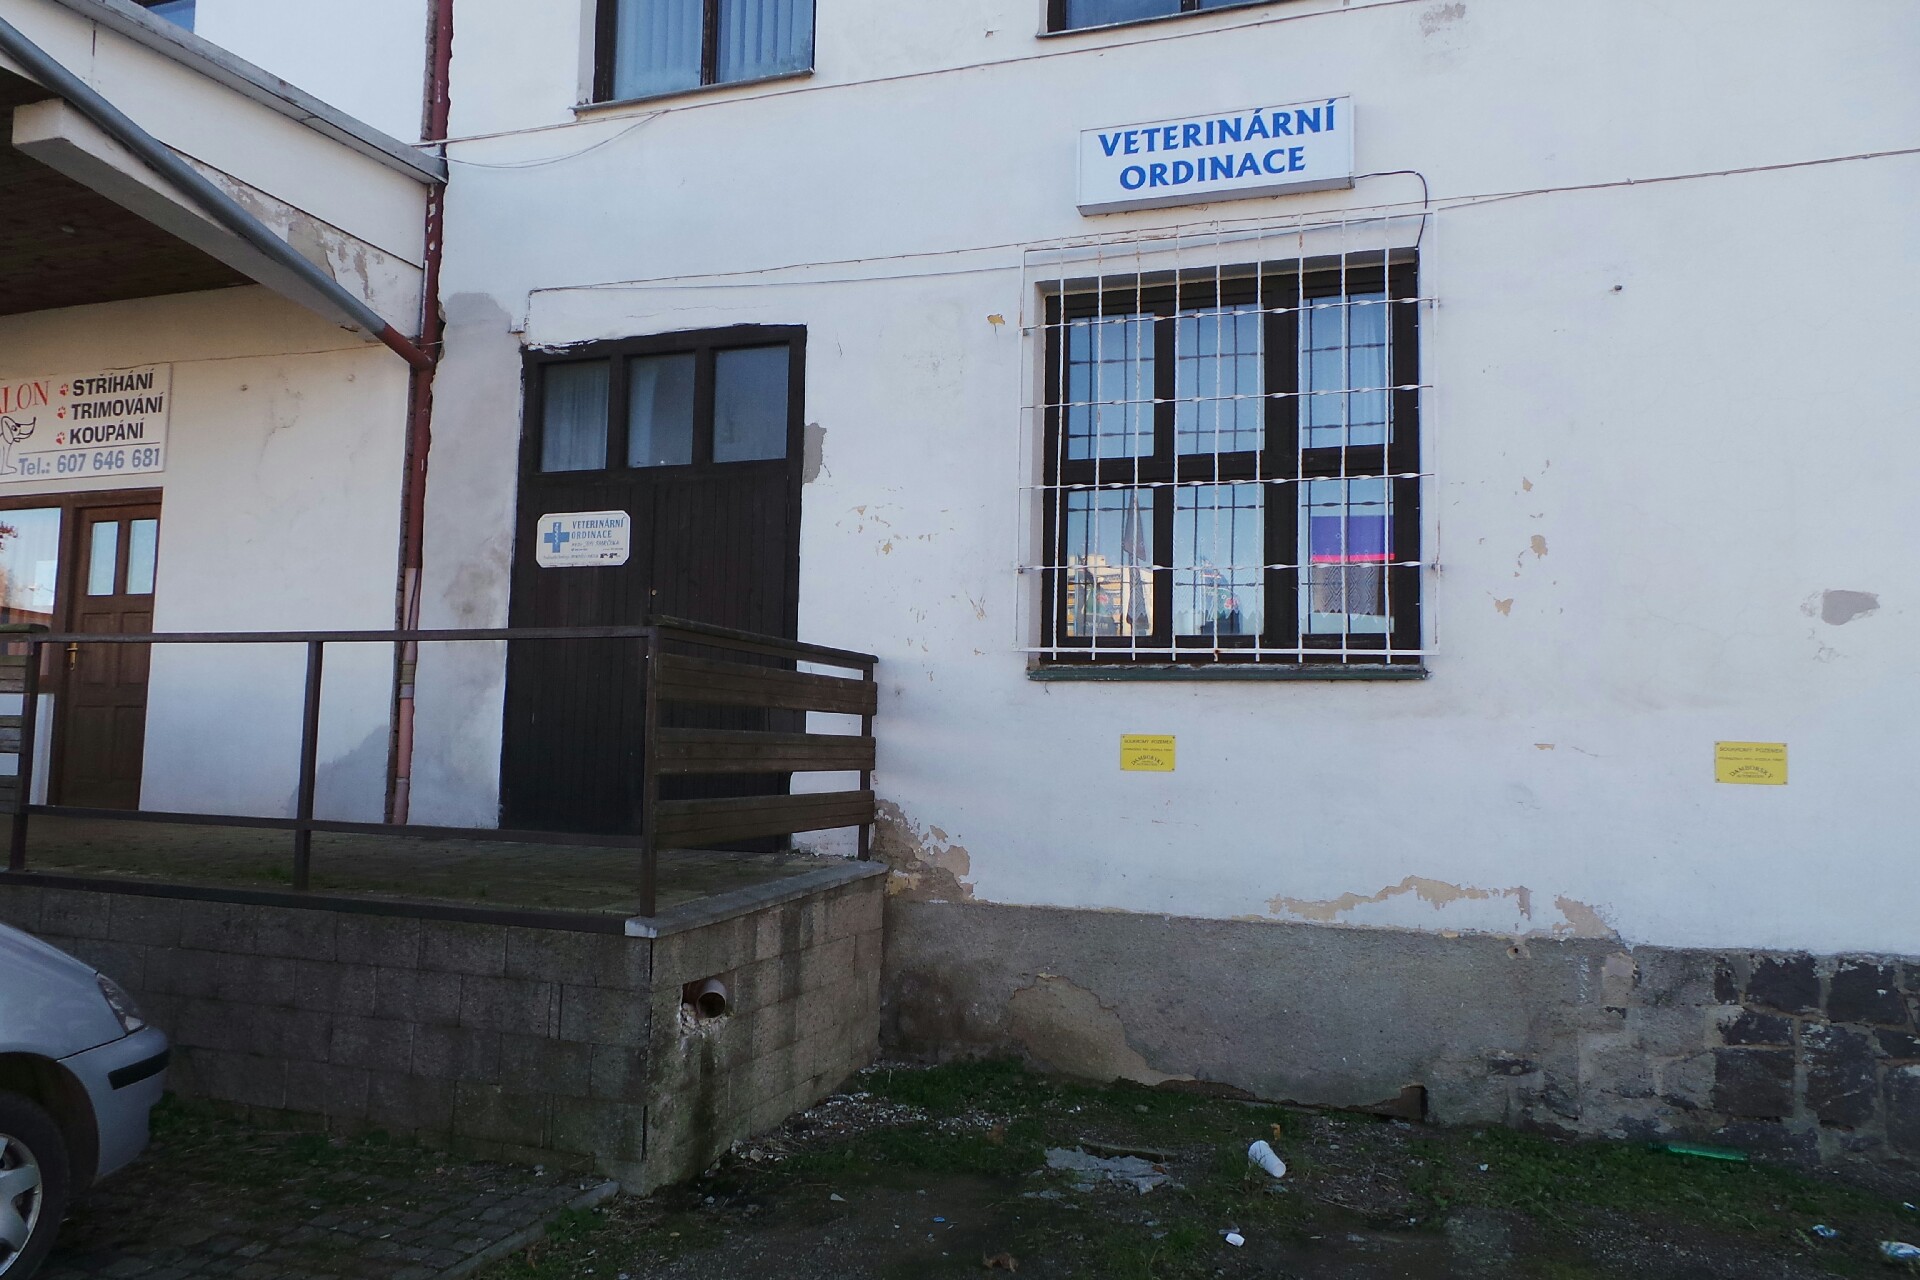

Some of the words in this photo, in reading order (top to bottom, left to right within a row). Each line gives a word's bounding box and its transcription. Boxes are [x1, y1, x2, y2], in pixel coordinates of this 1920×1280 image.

[1098, 98, 1337, 157] VETERINÁRNÍ
[1119, 146, 1306, 190] ORDINACE
[72, 369, 154, 397] STŘÍHÁNÍ
[71, 392, 164, 420] TRIMOVÁNÍ
[69, 418, 144, 445] KOUPÁNÍ
[18, 458, 50, 476] Tel.:
[57, 453, 86, 473] 607
[93, 450, 125, 471] 646
[132, 448, 160, 468] 681
[571, 530, 612, 540] ORDINACE
[572, 517, 625, 529] VETERINÁRNÍ
